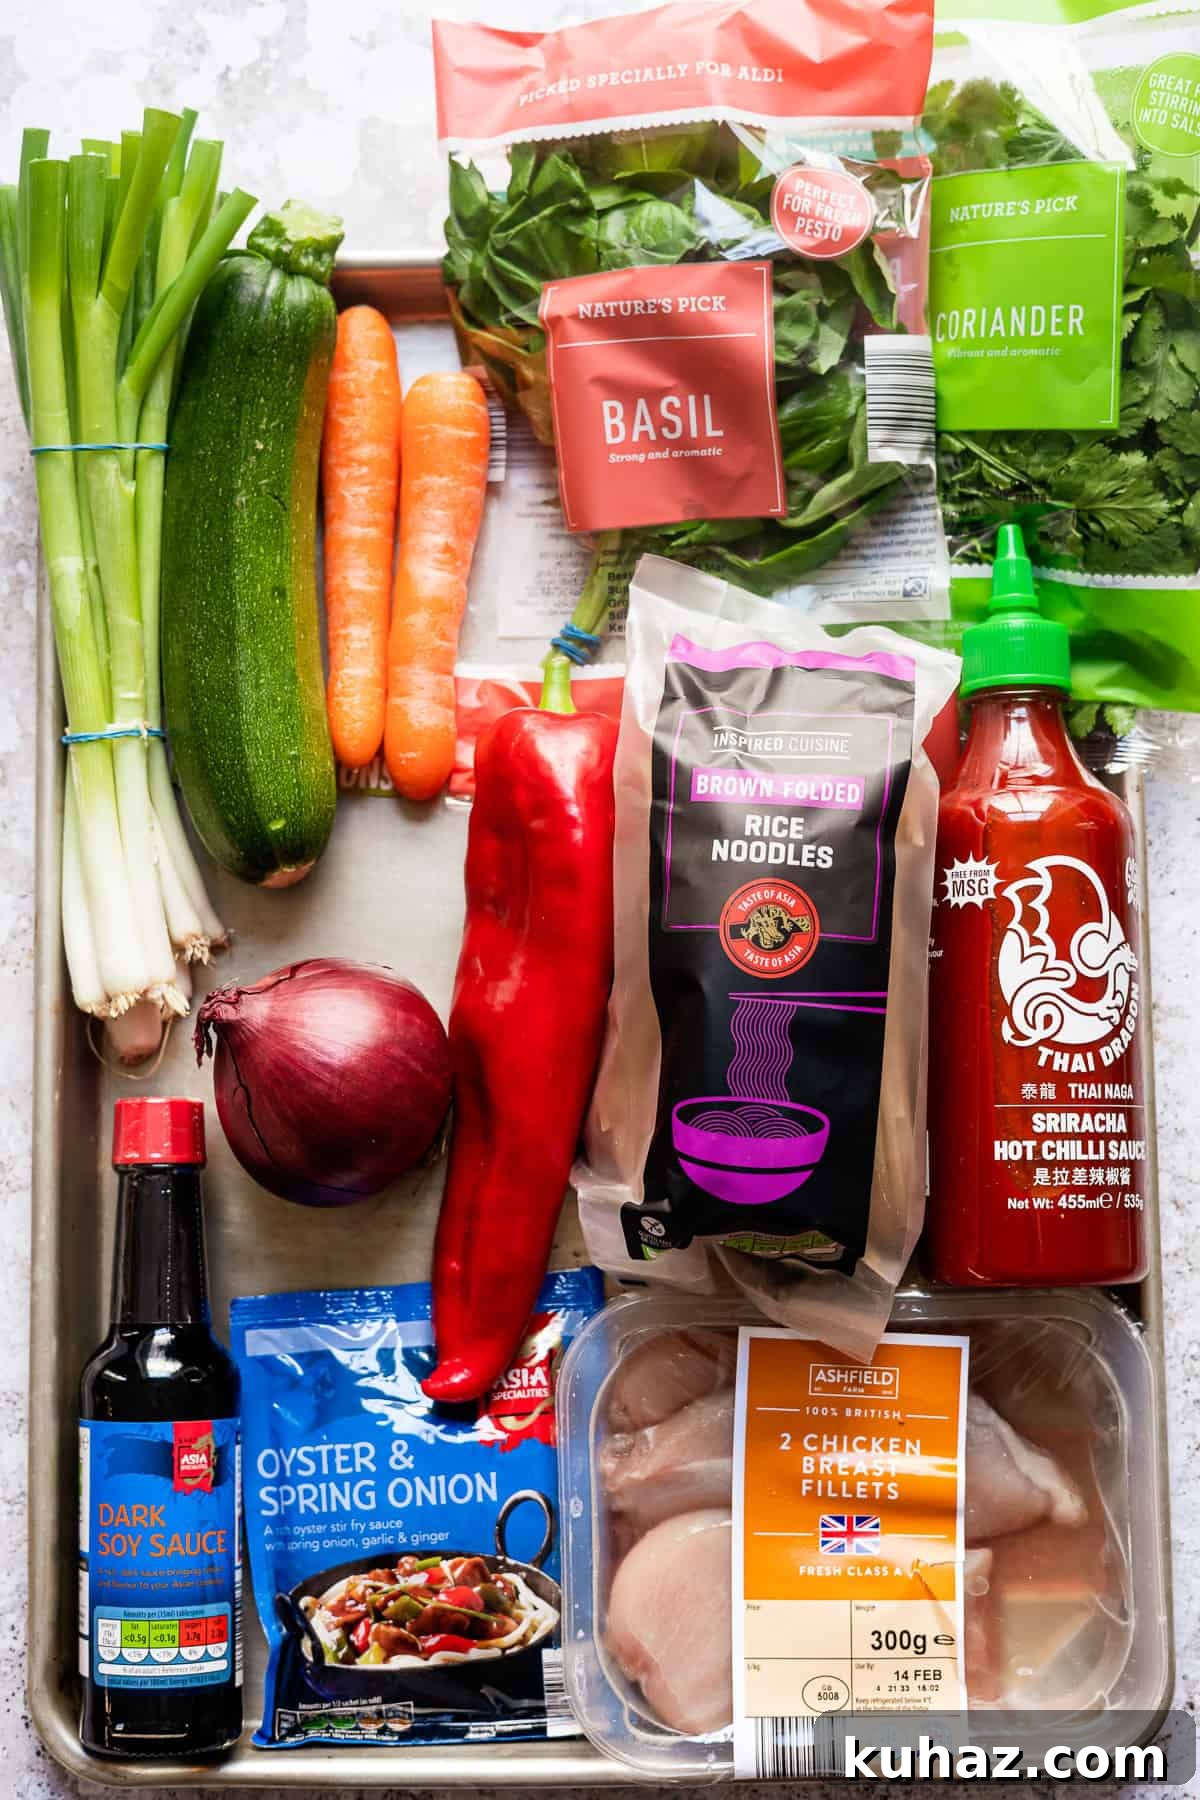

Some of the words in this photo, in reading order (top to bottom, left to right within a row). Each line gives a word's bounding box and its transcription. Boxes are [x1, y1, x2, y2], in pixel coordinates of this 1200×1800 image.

[519, 78, 580, 107] PICKED
[587, 63, 688, 89] SPECIALLY
[695, 61, 731, 79] FOR
[737, 67, 784, 84] ALDI
[1149, 73, 1192, 95] GREAT
[1150, 90, 1200, 117] STIRRIN
[1139, 108, 1168, 126] INTO
[1171, 113, 1200, 137] SALS
[782, 194, 810, 214] FOR
[795, 179, 856, 208] PERFECT
[949, 199, 1030, 223] NATURE'S
[1034, 195, 1078, 214] PICK
[795, 217, 842, 241] PESTO
[577, 297, 673, 319] NATURE'S
[678, 295, 726, 313] PICK
[935, 304, 1085, 342] CORIANDER
[602, 394, 724, 445] BASIL
[608, 451, 646, 465] Strong
[647, 447, 669, 460] and
[671, 446, 723, 458] aromatic
[713, 732, 783, 751] INSPIRED
[788, 736, 849, 753] CUISINE
[696, 775, 774, 798] BROWN
[783, 781, 861, 803] FOLDED
[744, 814, 805, 839] RICE
[711, 839, 834, 869] NOODLES
[952, 871, 968, 879] FREE
[969, 869, 990, 878] FROM
[952, 879, 988, 897] MSG
[738, 892, 763, 911] TASTE
[763, 889, 775, 899] OF
[776, 891, 796, 908] ASIA
[743, 949, 769, 967] TASTE
[771, 959, 783, 967] OF
[783, 945, 803, 962] ASIA
[1037, 1046, 1096, 1073] THAI
[1099, 982, 1138, 1066] DRAGON
[1068, 1083, 1101, 1099] THAI
[1104, 1083, 1134, 1099] NAGA
[1032, 1112, 1127, 1133] SRIRACHA
[993, 1140, 1037, 1160] HOT
[1041, 1140, 1105, 1160] CHILLI
[1007, 1197, 1029, 1209] Net
[1032, 1197, 1053, 1209] Wt:
[493, 1366, 548, 1389] ASIA
[815, 1369, 893, 1385] ASHFIELD
[492, 1388, 549, 1401] SPECIALITIES
[806, 1406, 838, 1417] 100%
[845, 1407, 901, 1419] BRITISH
[779, 1433, 792, 1450] 2
[803, 1433, 921, 1456] CHICKEN
[181, 1453, 208, 1465] ASIA
[256, 1441, 376, 1478] OYSTER
[389, 1439, 415, 1470] &
[802, 1456, 898, 1477] BREAST
[259, 1479, 376, 1517] SPRING
[387, 1471, 498, 1508] ONION
[801, 1479, 899, 1500] FILLETS
[98, 1503, 166, 1528] DARK
[264, 1525, 273, 1536] A
[293, 1522, 327, 1537] oyster
[330, 1521, 347, 1533] stir
[351, 1519, 365, 1533] fry
[368, 1519, 404, 1531] sauce
[98, 1533, 142, 1557] SOY
[150, 1530, 228, 1557] SAUCE
[322, 1537, 358, 1548] onion,
[361, 1533, 394, 1549] garlic
[398, 1532, 407, 1543] &
[411, 1530, 450, 1546] ginger
[799, 1566, 841, 1576] FRESH
[848, 1566, 888, 1576] CLASS
[893, 1566, 903, 1576] A
[124, 1632, 146, 1643] <0.5g
[153, 1632, 176, 1643] <0.1g
[871, 1630, 926, 1655] 300g
[894, 1670, 909, 1680] 14
[914, 1669, 942, 1680] FEB
[817, 1692, 839, 1701] 5008
